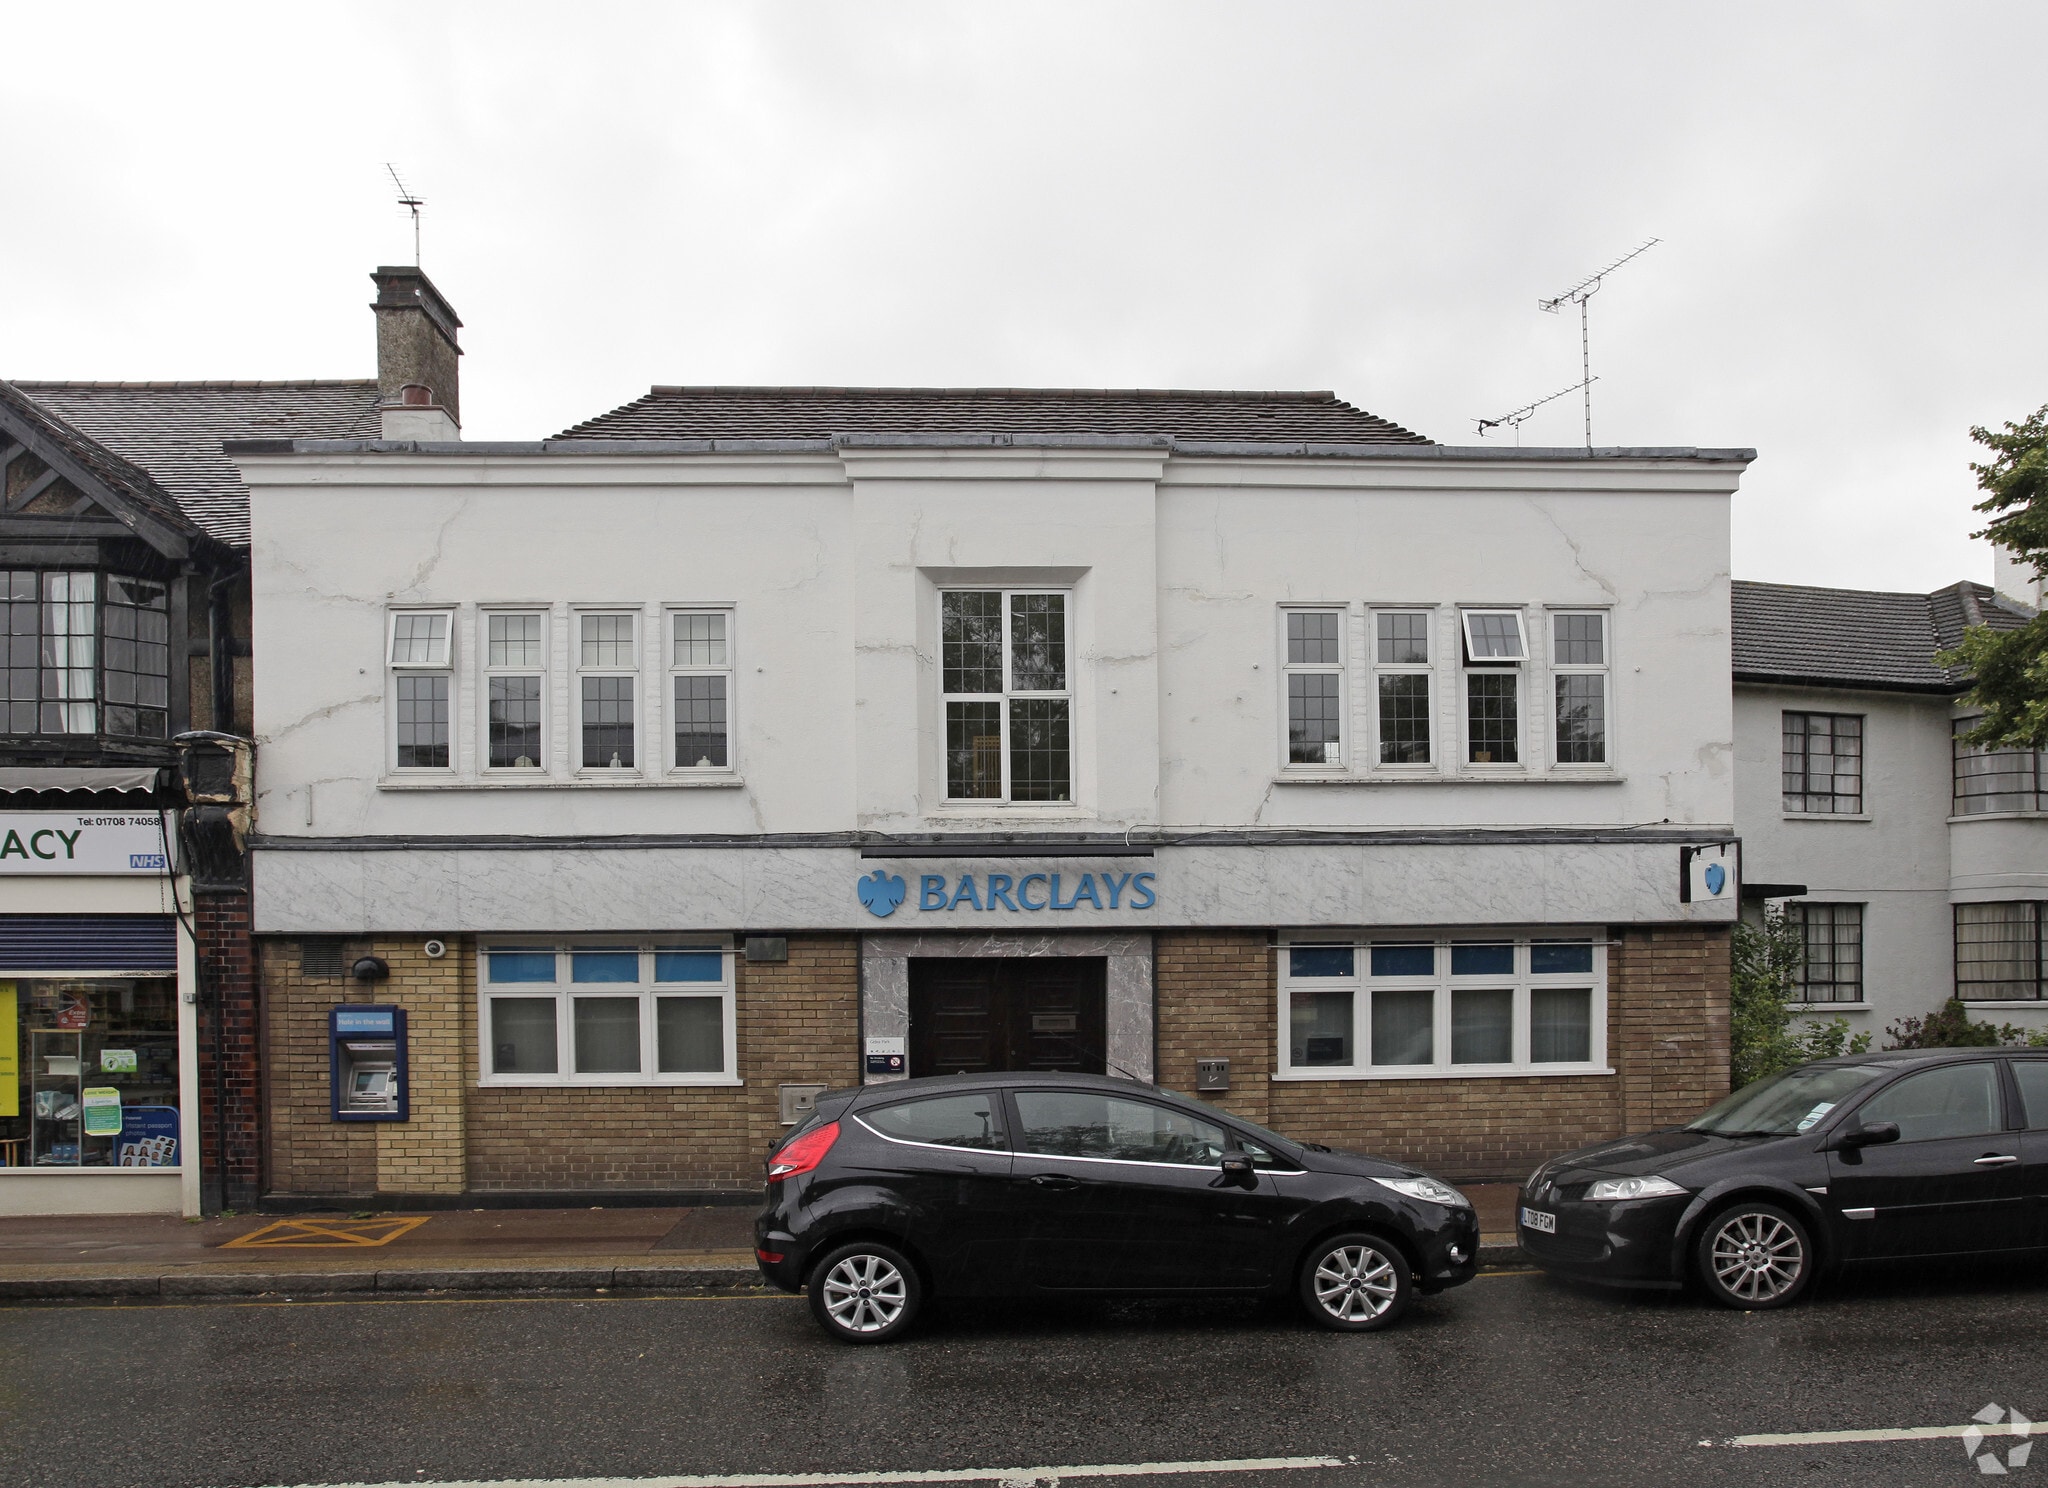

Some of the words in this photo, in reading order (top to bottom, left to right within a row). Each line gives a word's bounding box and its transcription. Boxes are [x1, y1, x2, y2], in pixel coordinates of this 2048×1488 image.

[77, 817, 94, 826] Tel:
[96, 817, 125, 826] 01708
[0, 829, 82, 860] ACY
[131, 855, 164, 867] NHS
[919, 872, 1156, 911] BARCLAYS
